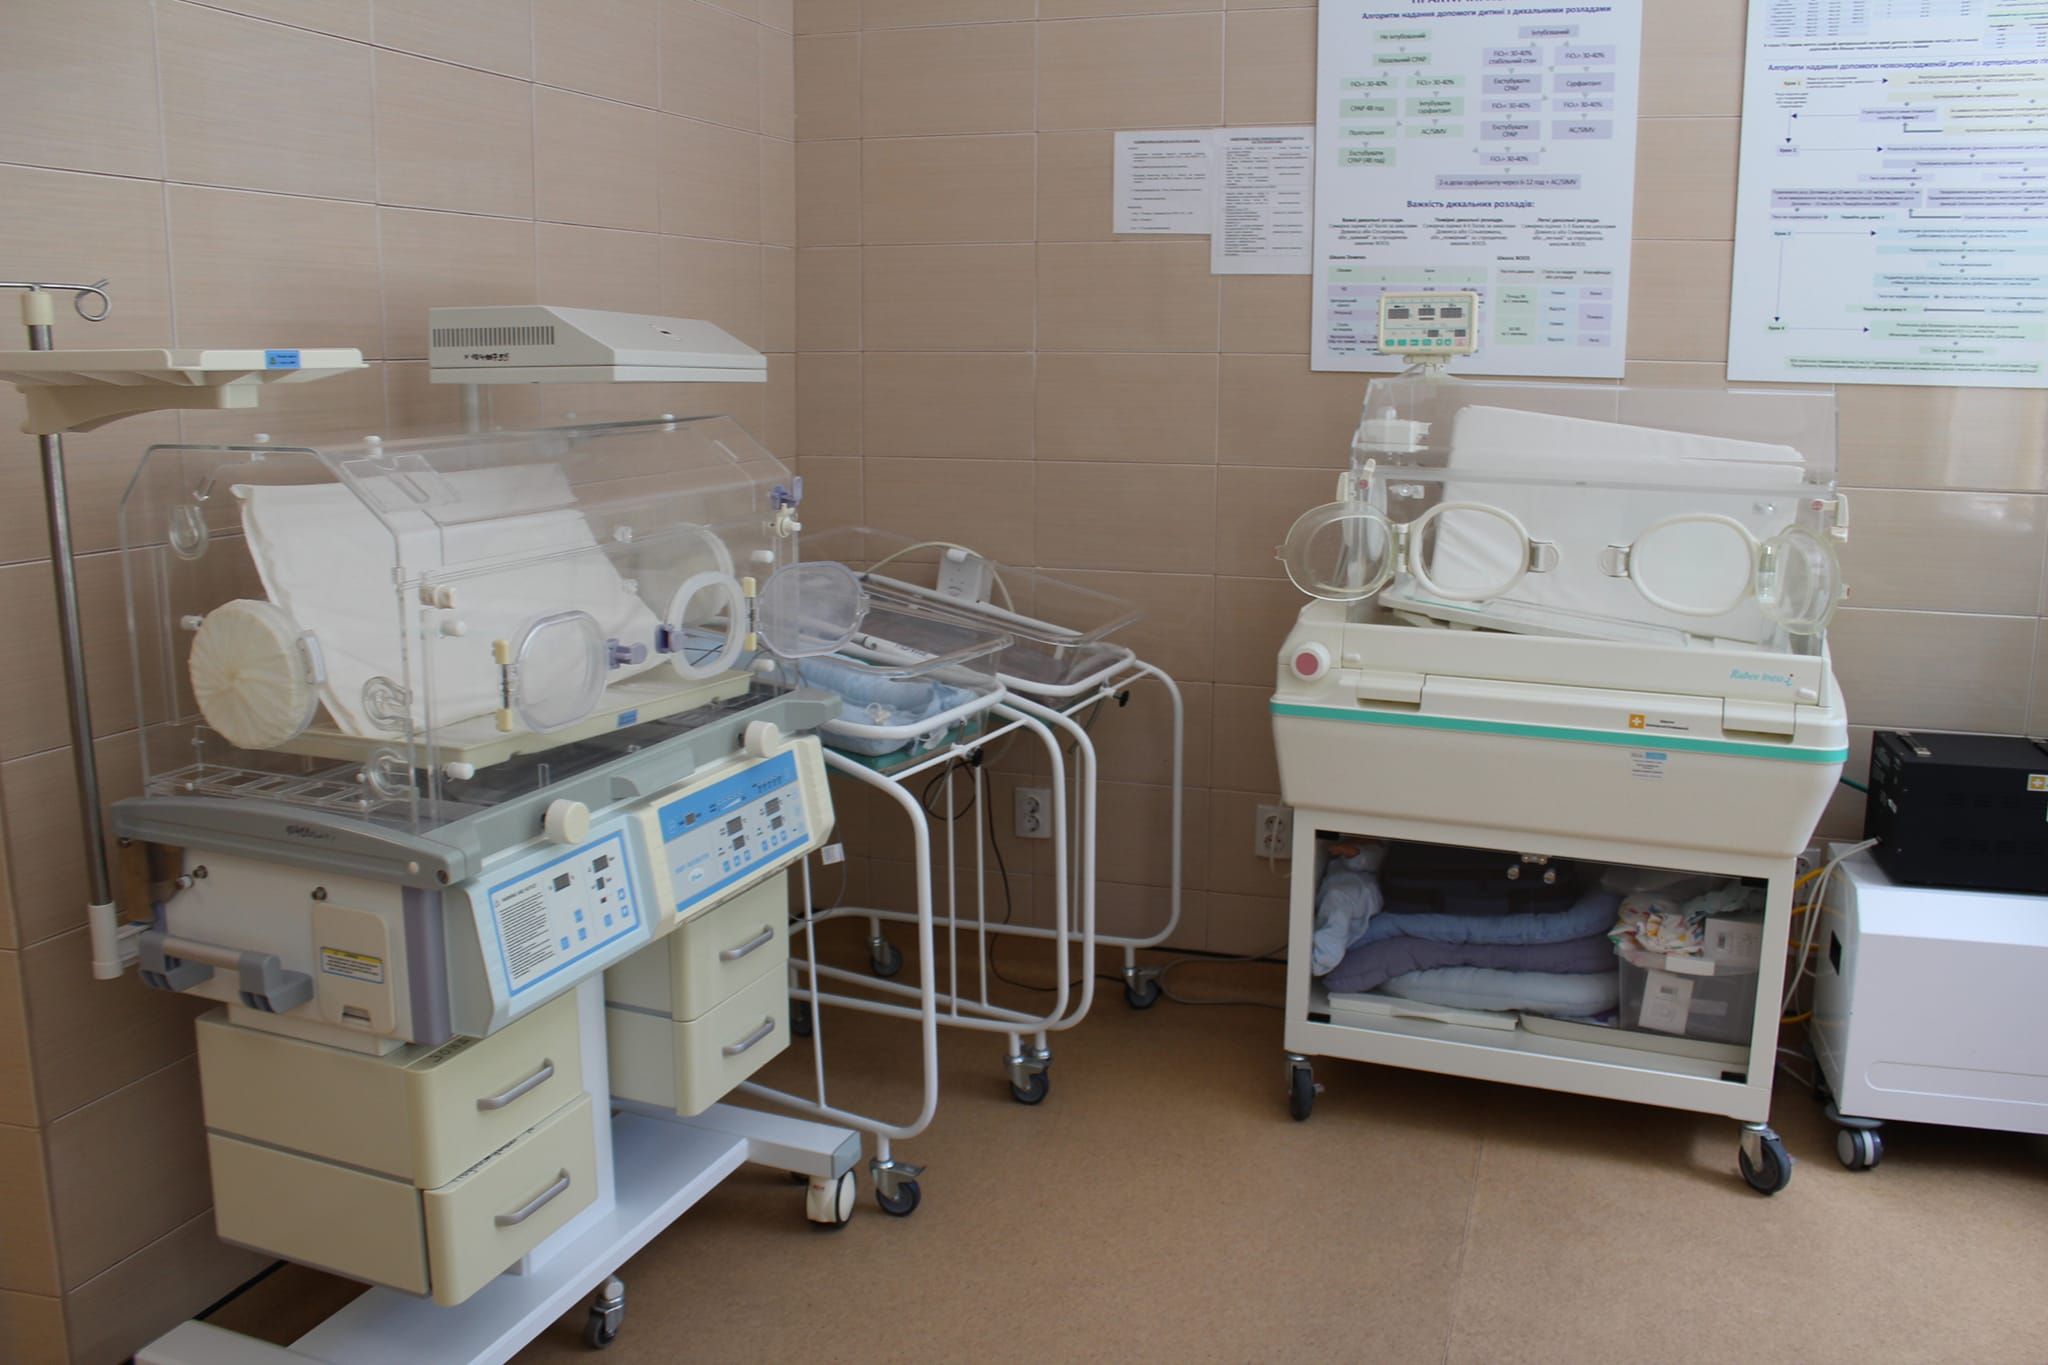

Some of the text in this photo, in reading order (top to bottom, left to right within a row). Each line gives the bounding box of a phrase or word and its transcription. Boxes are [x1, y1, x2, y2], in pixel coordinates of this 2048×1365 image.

[1512, 7, 1564, 15] дихальними
[1566, 6, 1612, 14] розладами
[1880, 60, 1946, 69] новонародженій
[1982, 59, 2038, 68] артеріальною
[1406, 200, 1536, 209] Важкість дихальних розладів:
